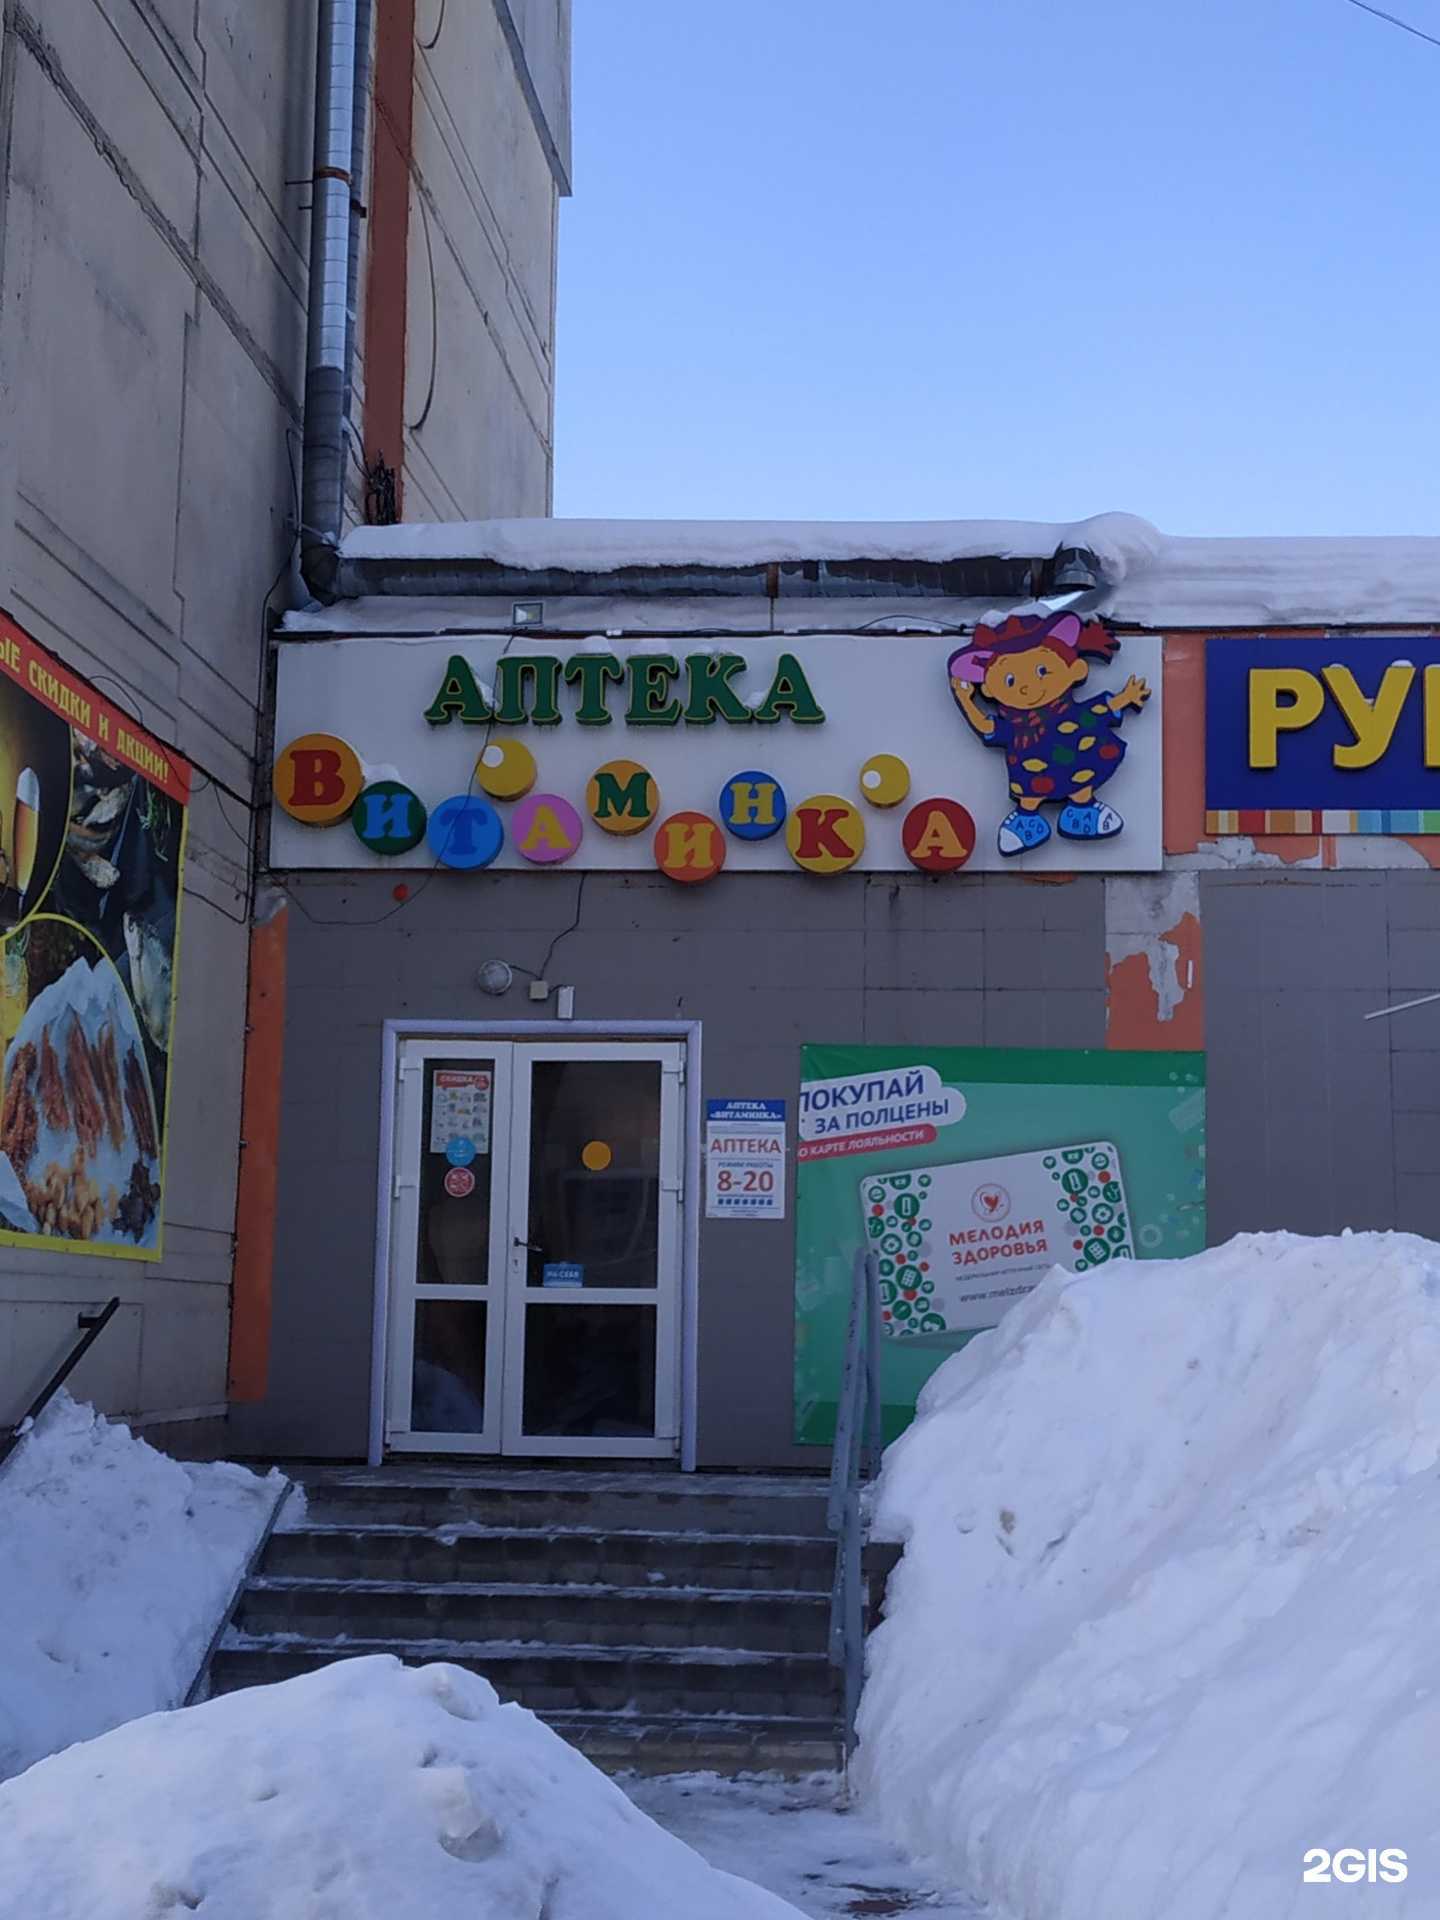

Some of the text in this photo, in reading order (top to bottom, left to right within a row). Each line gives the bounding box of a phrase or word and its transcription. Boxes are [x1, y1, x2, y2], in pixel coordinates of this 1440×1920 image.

[424, 653, 826, 726] АПТЕКА
[28, 660, 91, 728] СКИДКИ
[99, 713, 108, 741] И
[117, 728, 168, 783] АКЦИИ!
[288, 748, 968, 869] ВИТАМИНКА
[726, 1102, 766, 1110] АПТЕКА
[815, 1099, 949, 1133] ЗА ПОЛЦЕНЫ
[711, 1138, 782, 1153] АПТЕКА
[811, 1141, 846, 1155] КАРТЕ
[849, 1129, 925, 1150] ЛОЯЛЬНОСТИ
[717, 1170, 773, 1192] 8-20
[949, 1220, 1044, 1246] МЕЛОДИЯ
[952, 1239, 1048, 1265] ЗДОРОВЬЯ
